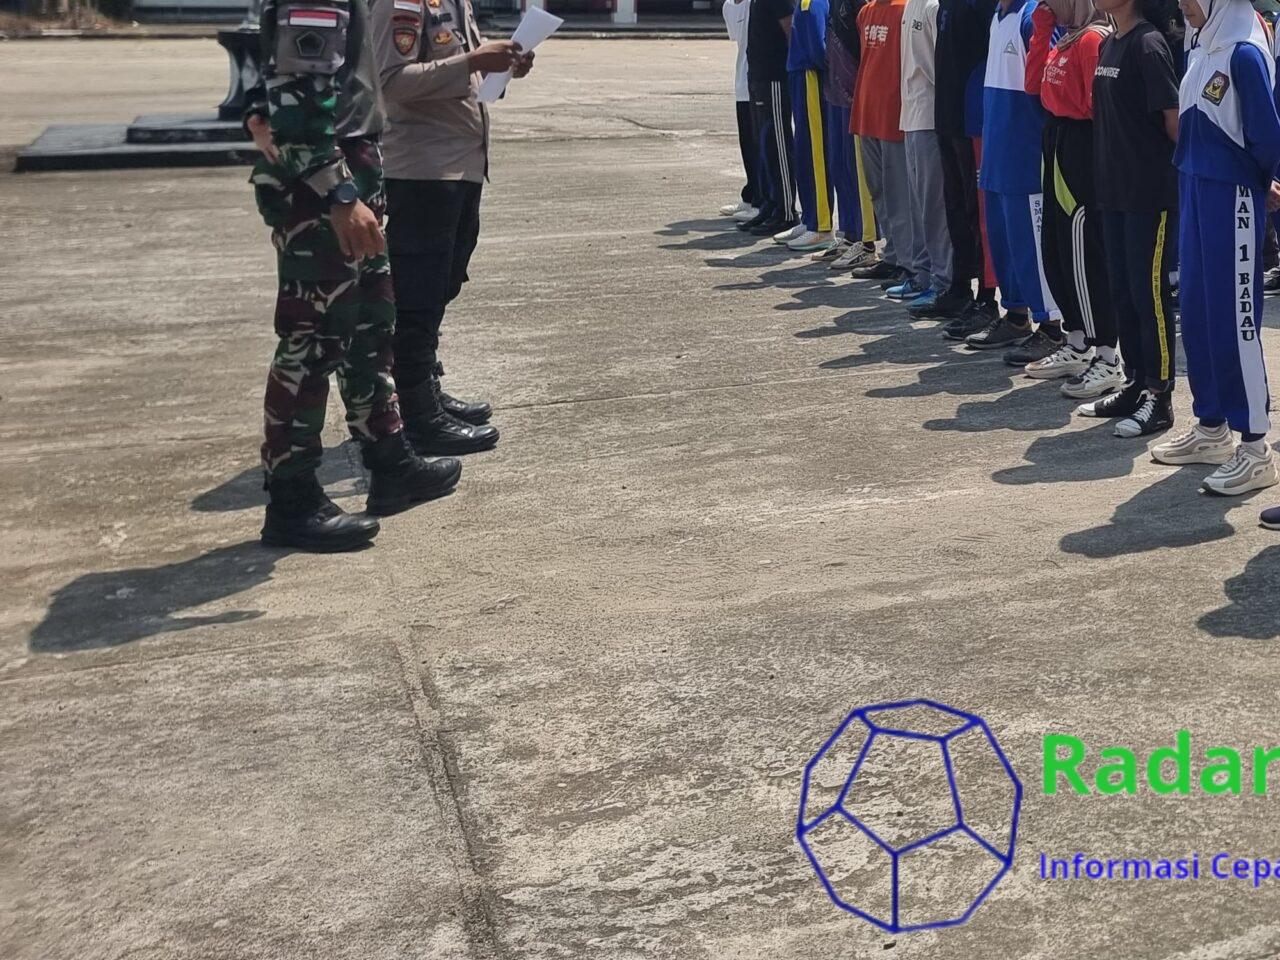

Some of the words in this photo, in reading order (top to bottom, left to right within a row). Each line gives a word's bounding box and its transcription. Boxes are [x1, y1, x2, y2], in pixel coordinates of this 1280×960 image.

[1237, 187, 1250, 229] MAN
[1239, 244, 1250, 262] 1
[1239, 272, 1255, 342] BADAU
